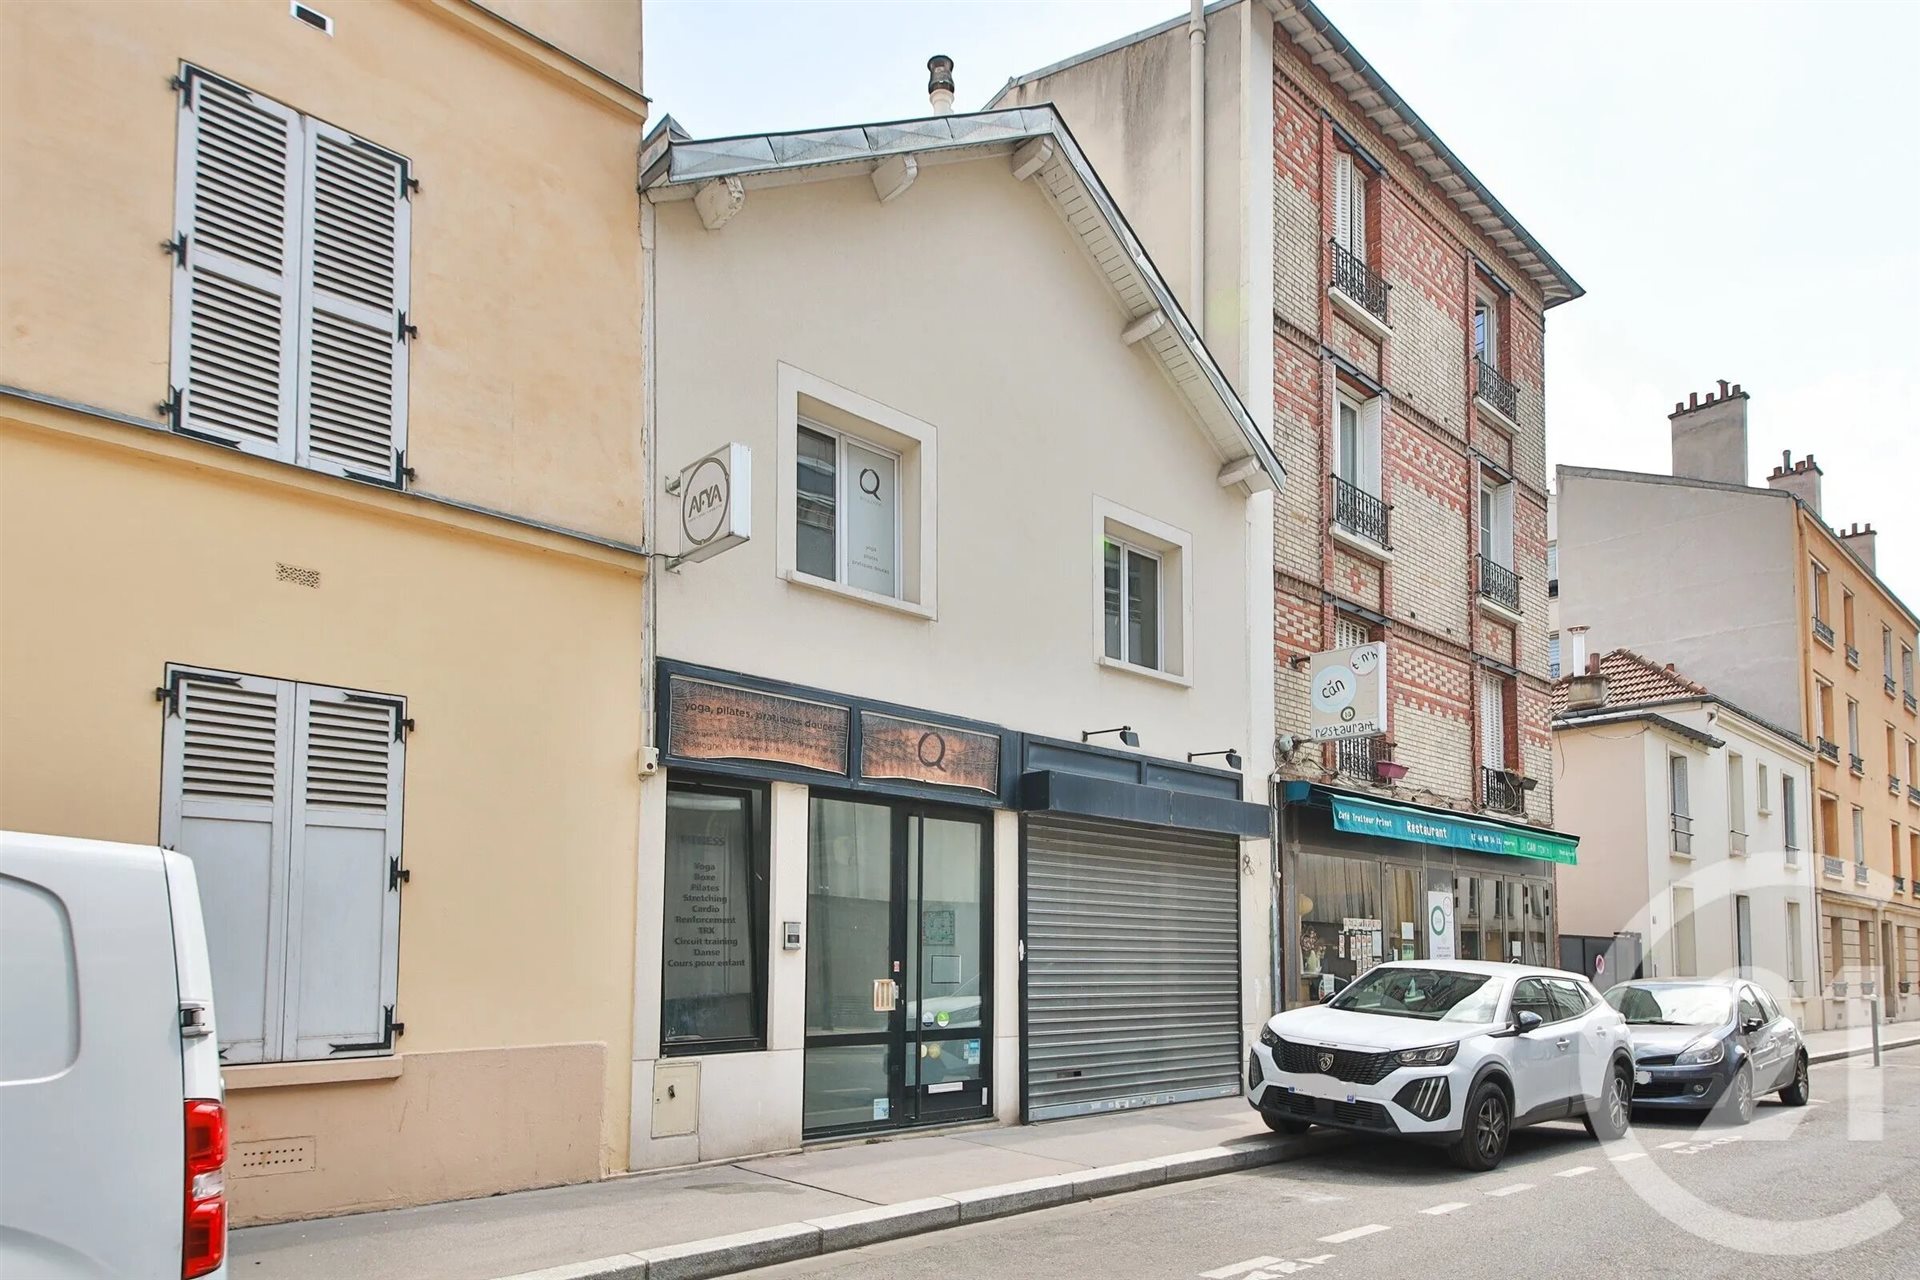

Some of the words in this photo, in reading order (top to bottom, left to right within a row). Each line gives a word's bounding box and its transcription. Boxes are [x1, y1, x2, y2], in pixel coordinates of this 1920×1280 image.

[684, 701, 714, 714] yoga,
[1315, 721, 1377, 738] restaurant
[1407, 821, 1447, 839] Restaurant
[694, 862, 716, 872] Yoga
[694, 873, 716, 881] Boxe
[690, 883, 720, 892] Pilates
[682, 894, 728, 904] Stretching
[692, 904, 720, 913] Cardio
[675, 915, 736, 924] Renforcement
[674, 937, 703, 945] Circuit
[705, 937, 738, 947] training
[694, 948, 720, 956] Danse
[668, 959, 694, 968] Cours
[695, 960, 716, 968] pour
[717, 958, 745, 967] enfant
